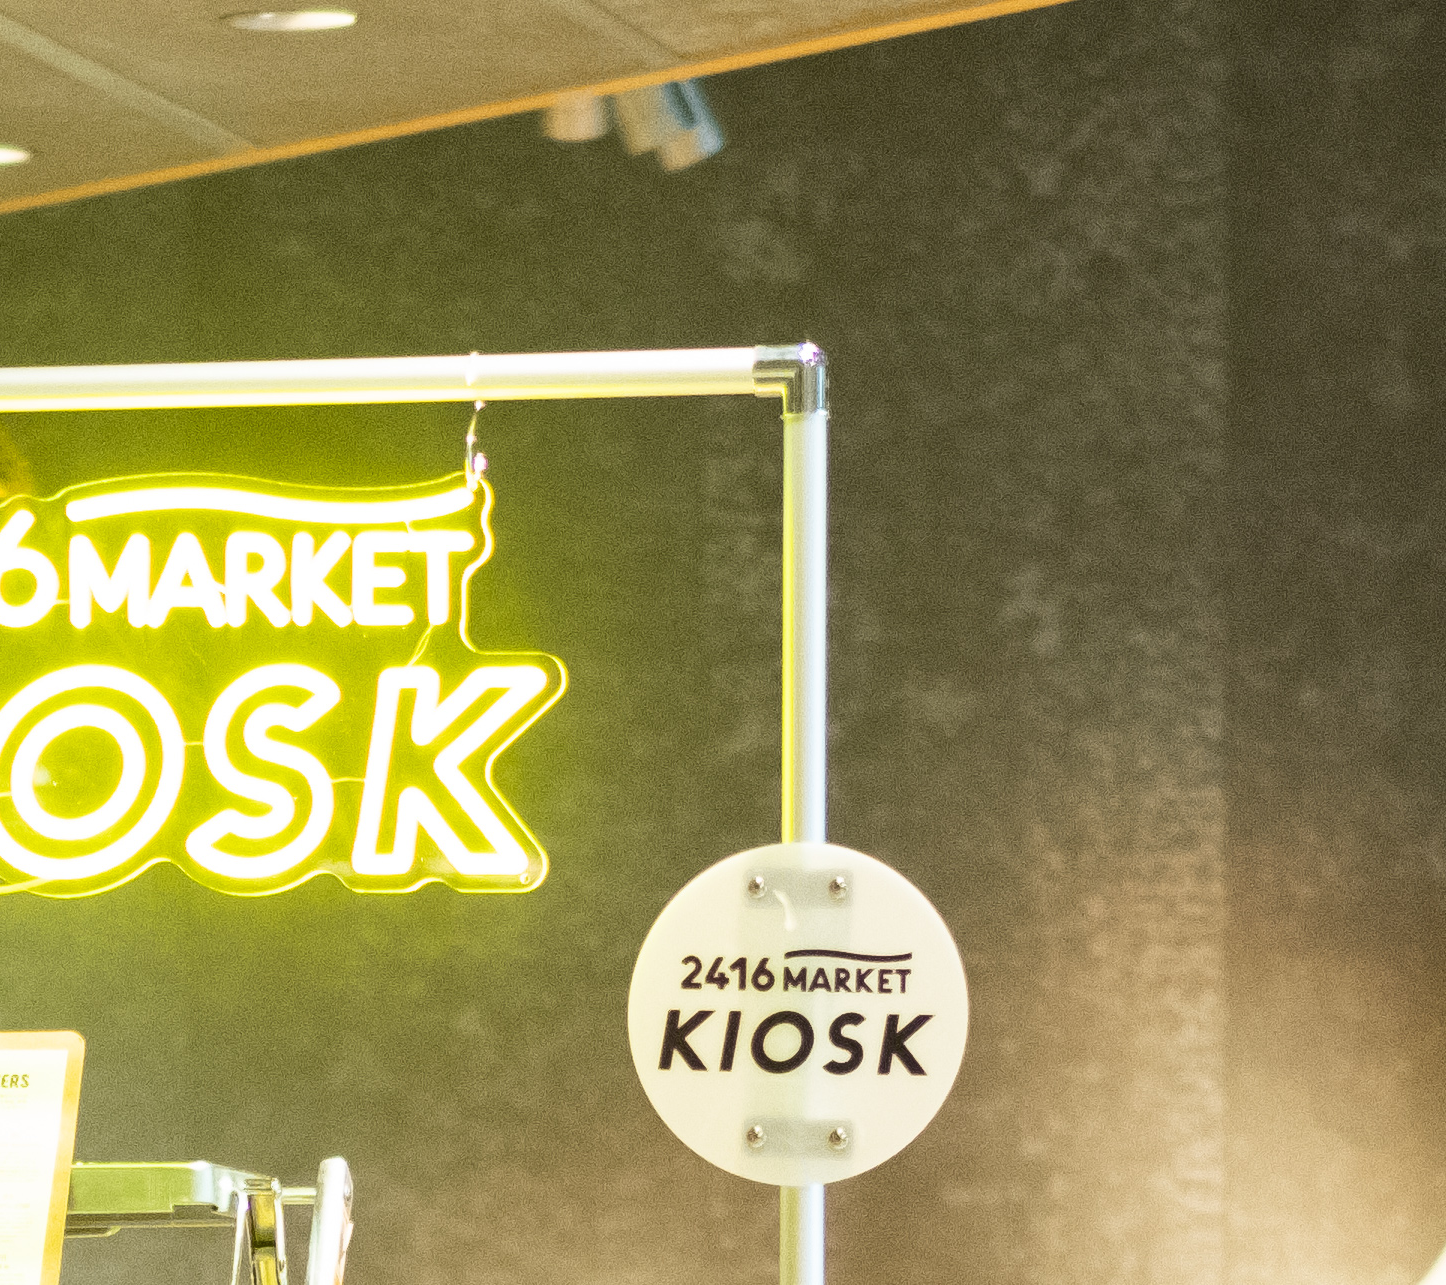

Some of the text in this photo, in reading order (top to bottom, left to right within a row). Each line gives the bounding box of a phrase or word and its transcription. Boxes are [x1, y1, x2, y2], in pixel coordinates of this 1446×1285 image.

[69, 530, 472, 628] MARKET
[681, 957, 910, 993] 2416 MARKET
[659, 1011, 932, 1076] KIOSK
